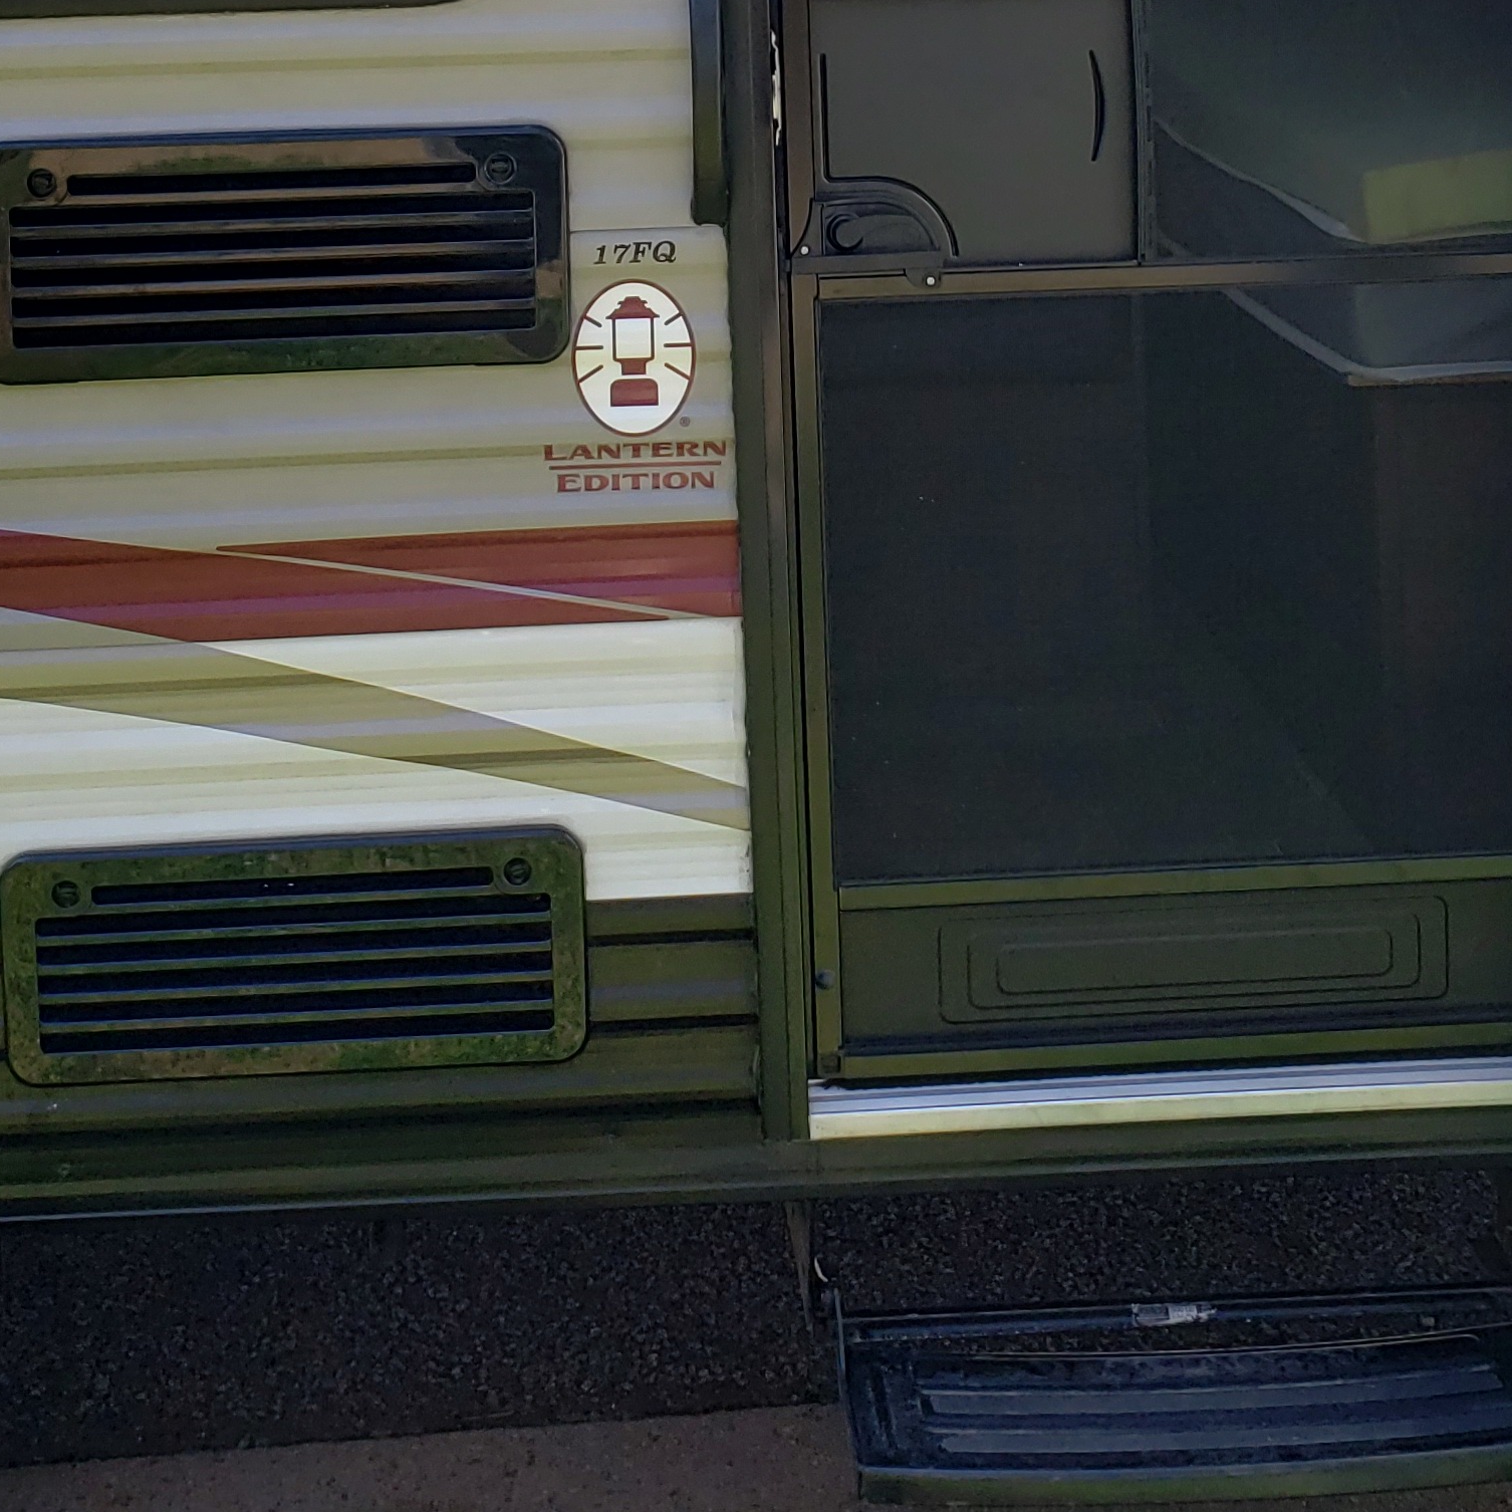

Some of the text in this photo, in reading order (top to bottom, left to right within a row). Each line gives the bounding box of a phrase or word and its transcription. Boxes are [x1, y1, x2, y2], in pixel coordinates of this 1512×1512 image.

[593, 240, 678, 265] 17FQ
[544, 441, 727, 461] LANTERN
[557, 472, 715, 493] EDITION
